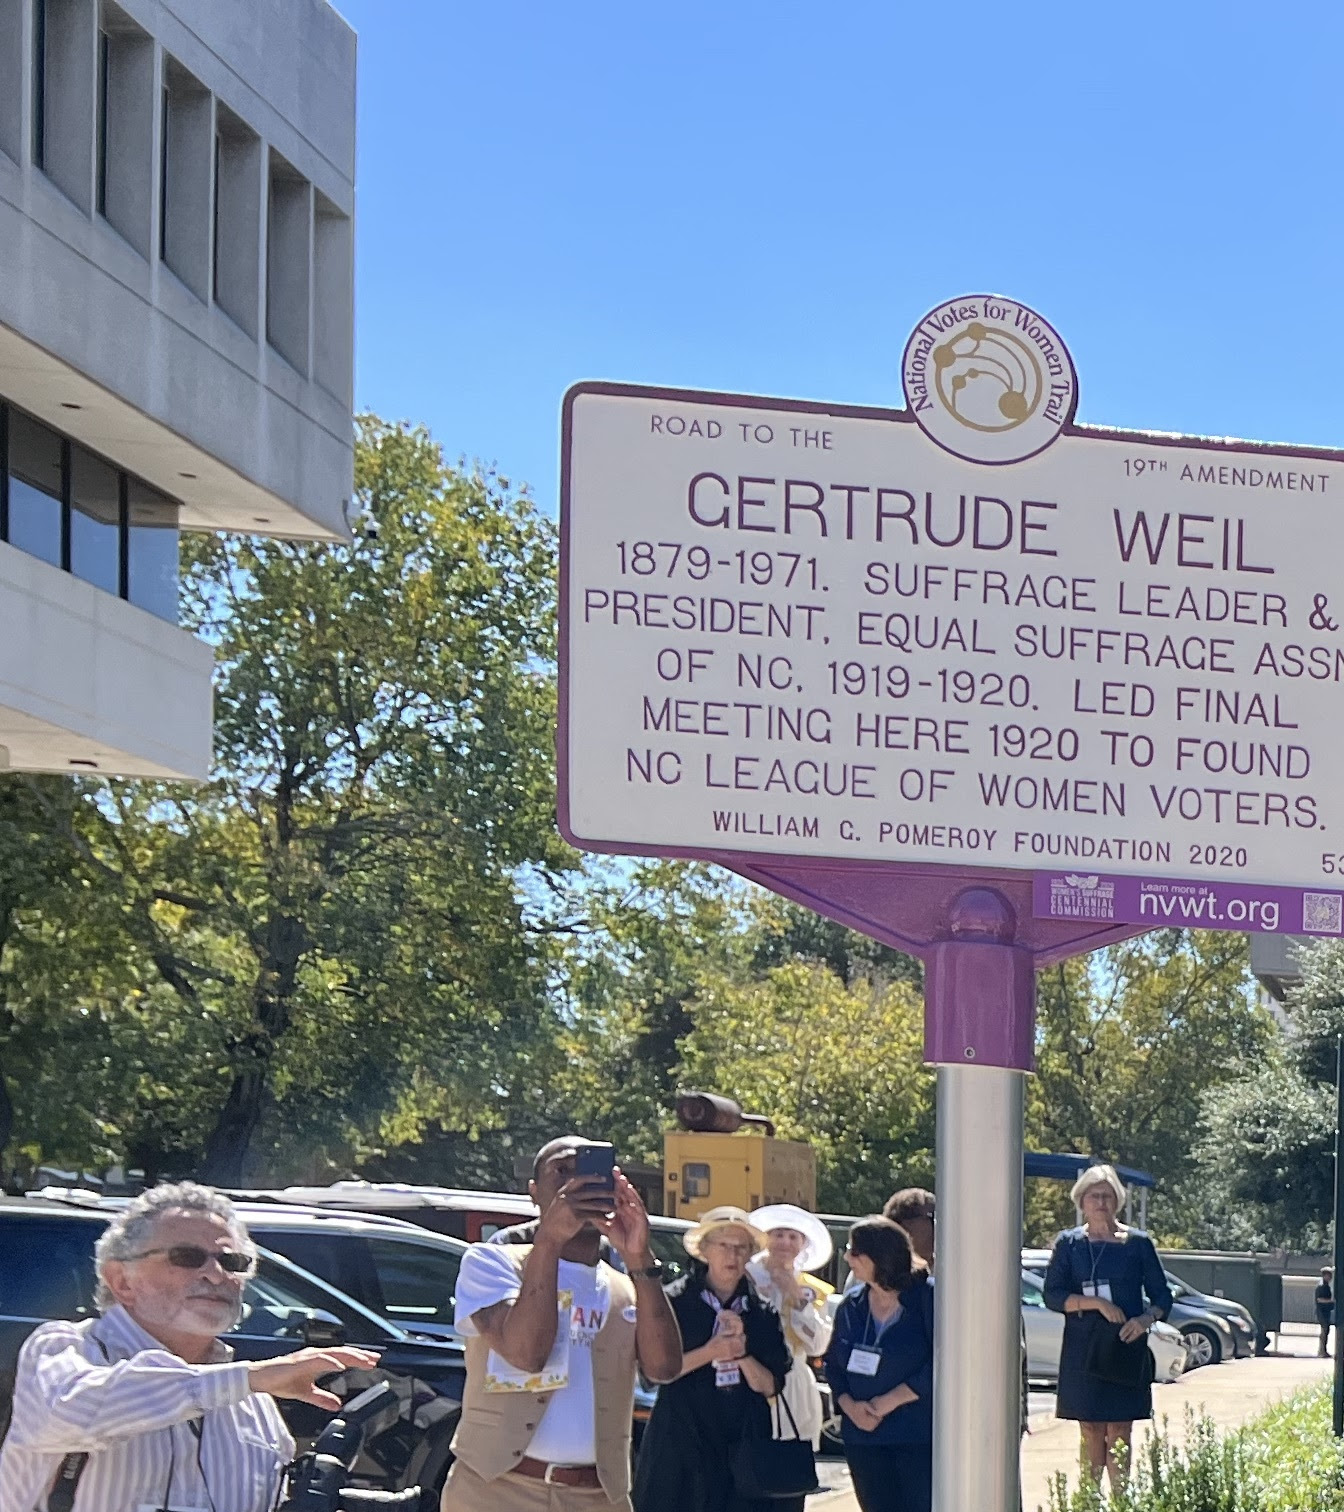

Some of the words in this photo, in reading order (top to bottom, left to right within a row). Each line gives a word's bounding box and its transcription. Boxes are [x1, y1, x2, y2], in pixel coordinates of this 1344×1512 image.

[906, 328, 936, 413] National
[926, 304, 978, 333] Votes
[983, 299, 1011, 320] for
[1014, 308, 1064, 376] Women
[1043, 380, 1070, 425] Trail
[651, 415, 722, 438] ROAD
[739, 424, 773, 443] TO
[790, 428, 832, 450] THE
[1180, 464, 1329, 492] AMENDMENT
[688, 472, 1058, 557] GERTRUDE
[1113, 508, 1274, 574] WEIL
[617, 541, 828, 591] 1879-1971.
[864, 562, 1096, 612] SUFFRAGE
[1119, 581, 1287, 627] LEADER
[1309, 593, 1339, 631] &
[585, 589, 829, 644] PRESIDENT,
[859, 612, 996, 654] EQUAL
[1014, 624, 1235, 673] SUFFRAGE
[658, 648, 714, 682] OF
[828, 661, 1038, 711] 1919-1920.
[1074, 679, 1154, 717] LED
[1177, 687, 1298, 729] FINAL
[643, 696, 831, 744] MEETING
[857, 713, 969, 754] HERE
[989, 724, 1079, 761] 1920
[1101, 730, 1154, 767] TO
[1177, 737, 1310, 779] FOUND
[627, 748, 681, 784] NC
[706, 754, 876, 798] LEAGUE
[900, 769, 955, 802] OF
[978, 773, 1125, 816] WOMEN
[1149, 785, 1326, 830] VOTERS.
[713, 811, 819, 838] WILLIAM
[840, 820, 860, 841] G.
[880, 822, 997, 850] POMEROY
[1015, 832, 1170, 862] FOUNDATION
[1190, 845, 1247, 867] 2020
[1051, 895, 1113, 908] CENTENNIAL
[1051, 905, 1113, 918] COMMISSION
[1140, 882, 1168, 892] Learn
[1171, 886, 1195, 894] more
[1199, 887, 1208, 895] at
[1140, 892, 1279, 930] nvwt.org
